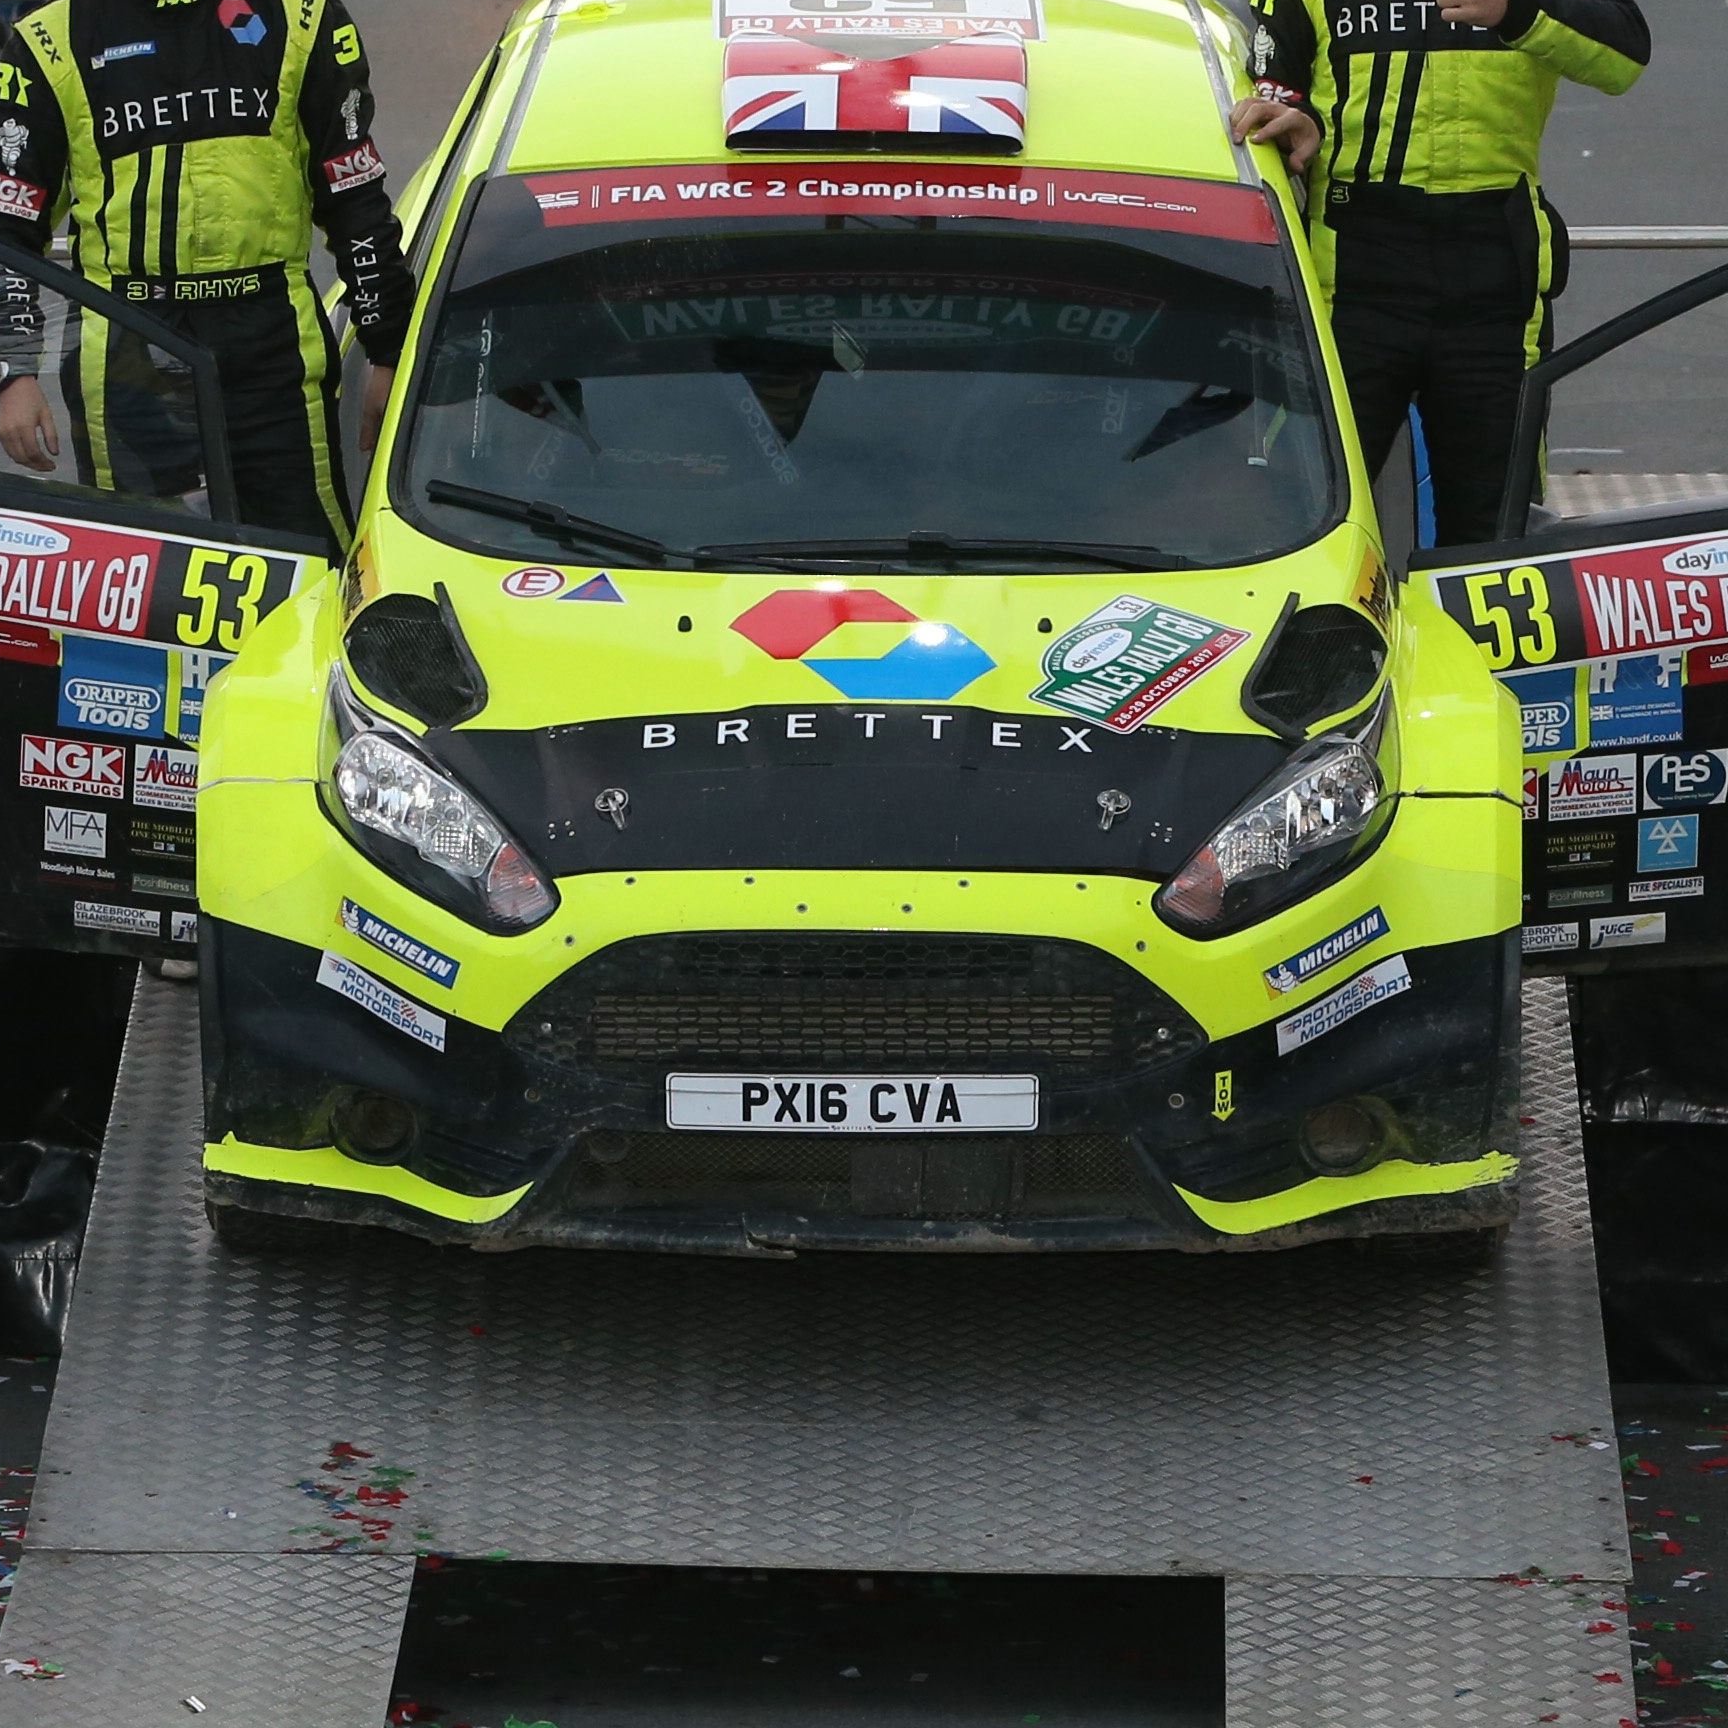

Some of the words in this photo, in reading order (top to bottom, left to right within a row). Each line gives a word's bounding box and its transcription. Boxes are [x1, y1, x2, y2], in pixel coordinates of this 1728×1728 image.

[29, 21, 64, 65] HRX
[332, 23, 361, 65] 3
[103, 87, 270, 138] BRETTEX
[332, 143, 377, 180] NGK
[610, 184, 666, 204] FIA
[676, 181, 752, 200] WRC
[766, 180, 785, 197] 2
[798, 179, 1039, 206] Championship
[175, 274, 260, 300] RHYS
[98, 554, 150, 633] GB
[176, 547, 269, 653] 53
[1583, 571, 1712, 652] WALES
[1153, 611, 1214, 641] GB
[1464, 565, 1558, 671] 53
[1071, 631, 1125, 669] dayinsure
[1116, 628, 1191, 674] RALLY
[74, 683, 152, 709] DRAPER
[1045, 665, 1147, 714] WALES
[1115, 700, 1147, 725] 26-29
[1142, 666, 1191, 703] OCTOBER
[1188, 648, 1214, 668] 2017
[76, 701, 150, 731] Tools
[642, 713, 1093, 753] BRETTEX
[23, 738, 123, 784] NGK
[1591, 732, 1683, 748] www.handf.co.uk
[22, 775, 68, 791] SPARK
[72, 782, 121, 797] PLUGS
[1550, 802, 1593, 813] COMMERCIAL
[1595, 798, 1634, 808] VEHICLE
[47, 808, 104, 840] MFA
[1630, 883, 1650, 894] TYRE
[1652, 879, 1704, 892] SPECIALISTS
[75, 902, 146, 919] GLAZEBROOK
[75, 911, 138, 927] TRANSPORT
[139, 917, 159, 928] LTD
[362, 917, 452, 978] MICHELIN
[1298, 913, 1380, 974] MICHELIN
[336, 961, 401, 1010] PROTYRE
[340, 980, 444, 1047] MOTORSPORT
[1291, 984, 1359, 1033] PROTYRE
[1300, 974, 1409, 1043] MOTORSPORT
[740, 1080, 849, 1124] PX16
[869, 1082, 963, 1124] CVA
[1217, 1075, 1229, 1113] TOW
